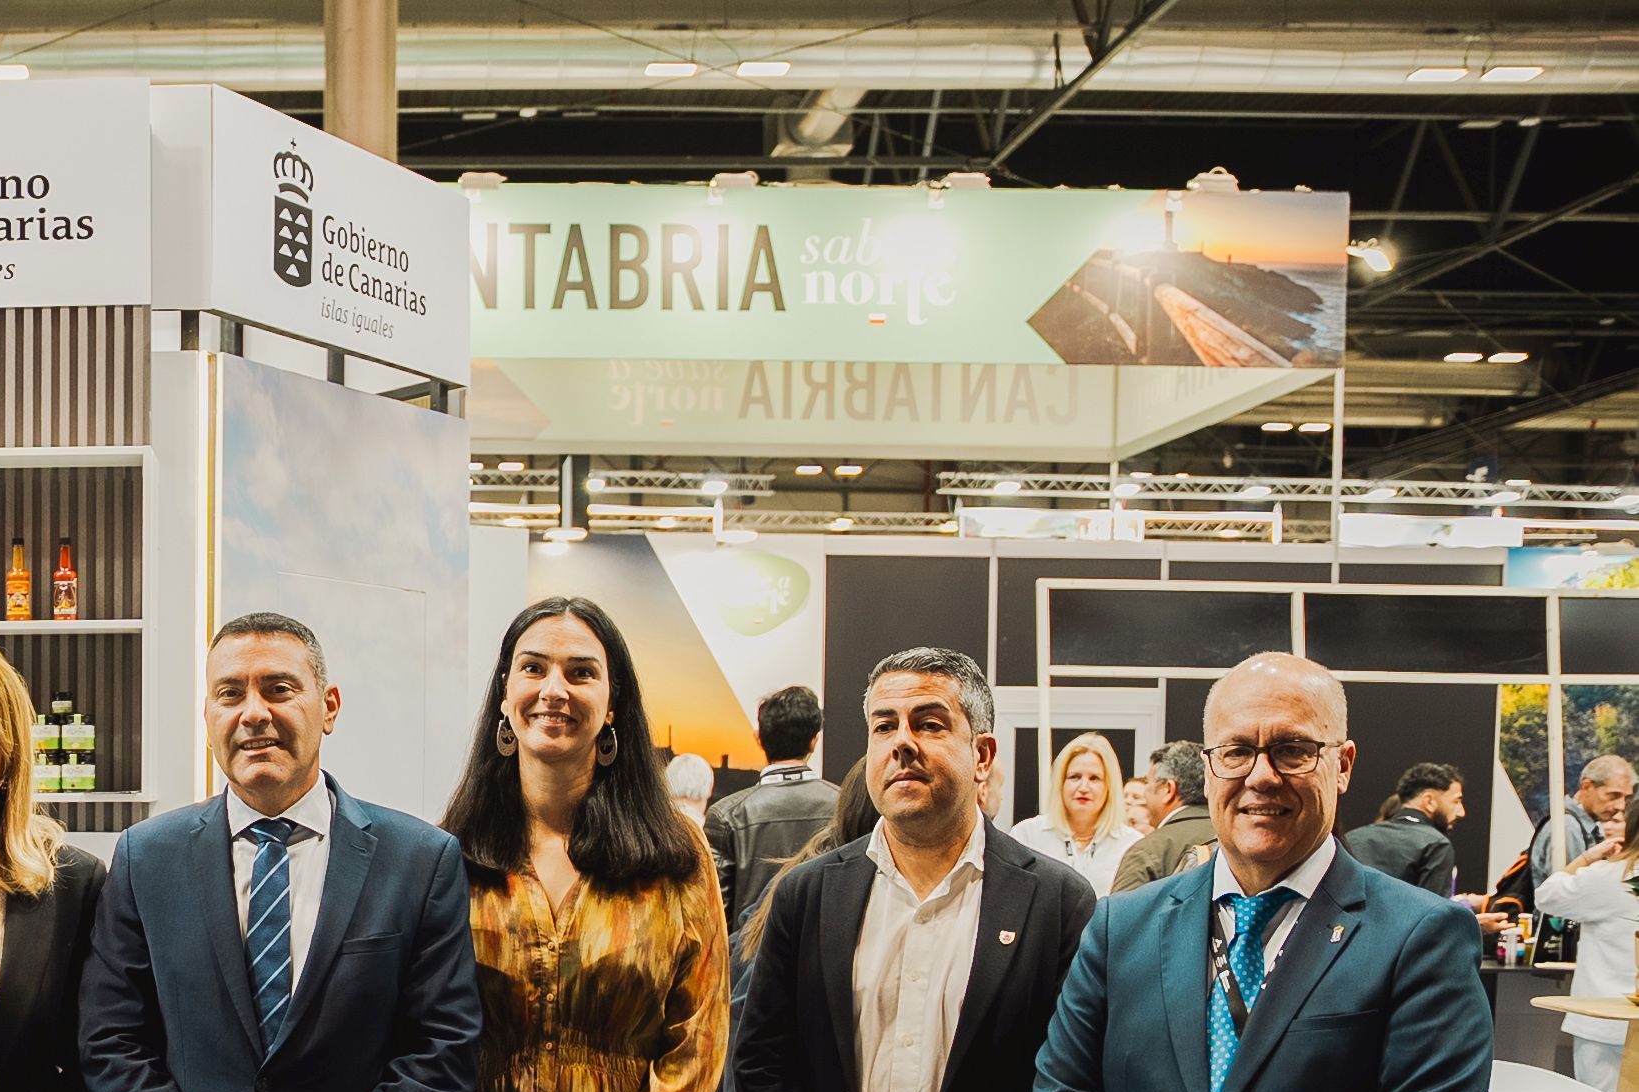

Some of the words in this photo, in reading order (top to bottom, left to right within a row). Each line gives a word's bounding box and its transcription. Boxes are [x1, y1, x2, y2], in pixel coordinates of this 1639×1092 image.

[322, 215, 409, 272] Gobierno
[322, 252, 344, 286] de
[349, 263, 427, 316] Canarias
[321, 296, 348, 325] islas
[351, 306, 394, 339] iguales
